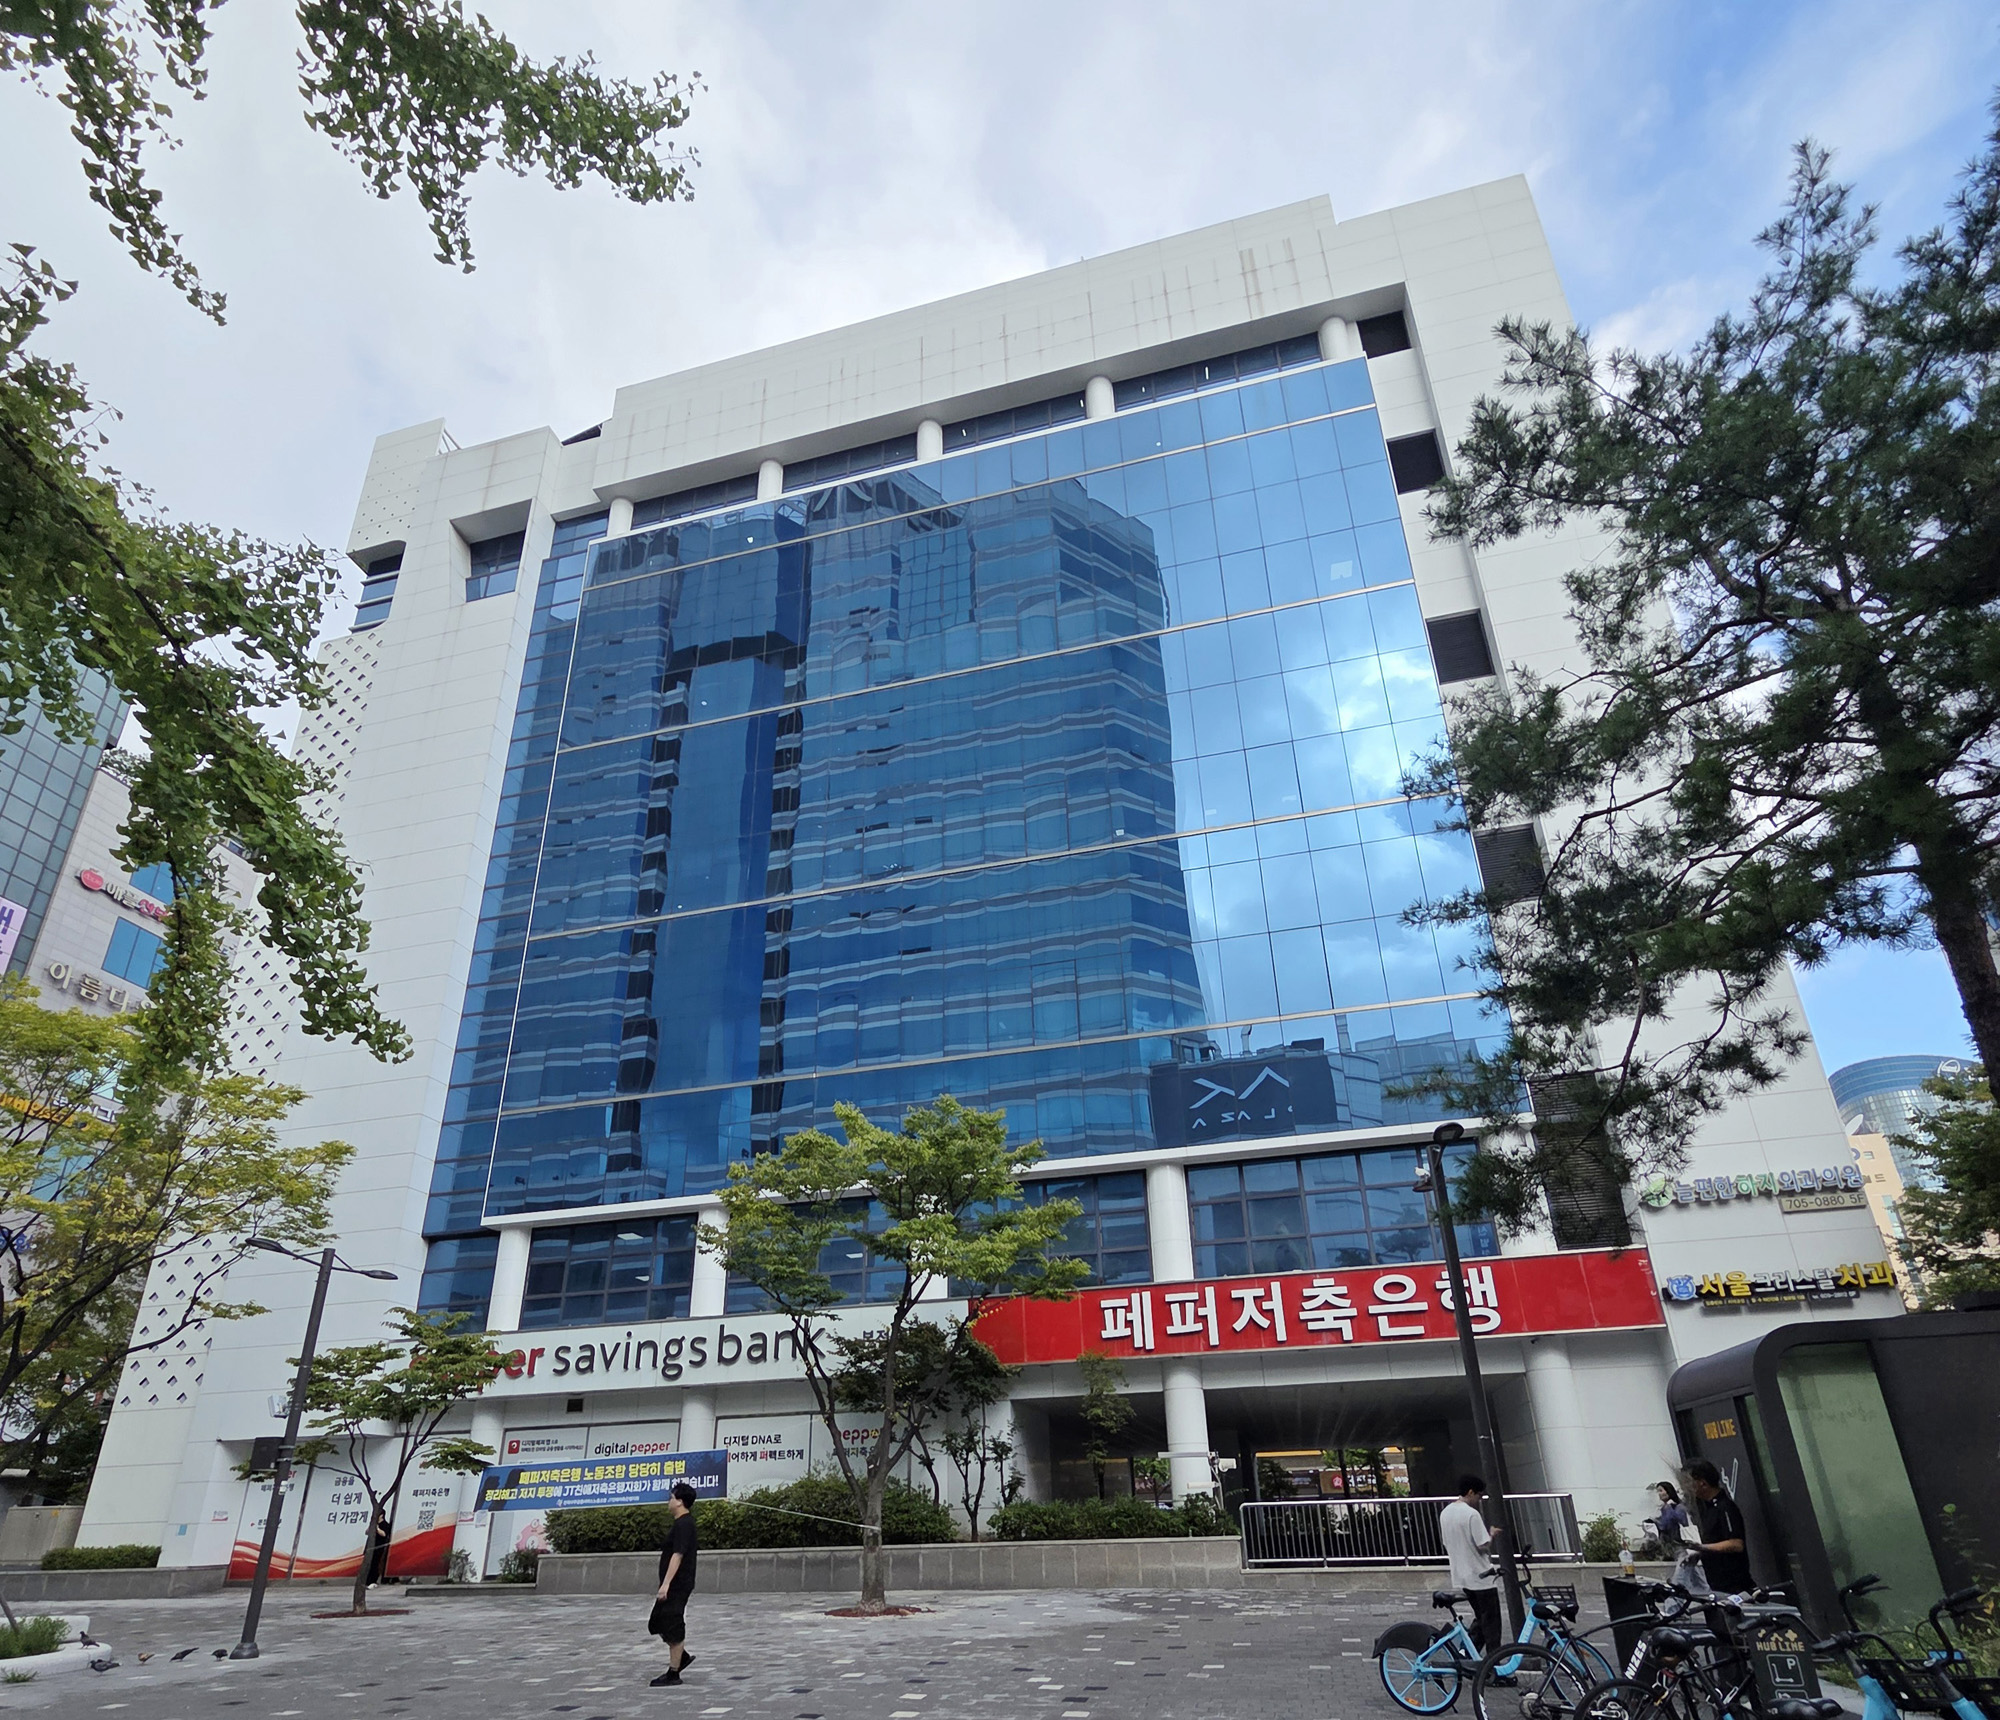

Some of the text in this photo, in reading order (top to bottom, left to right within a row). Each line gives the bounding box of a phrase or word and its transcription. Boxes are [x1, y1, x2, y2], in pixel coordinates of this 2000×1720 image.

[49, 962, 158, 1014] 아름다
[1786, 1194, 1865, 1210] 705-0880 5F
[1100, 1265, 1502, 1350] 페퍼저축은행
[553, 1331, 708, 1381] savings
[723, 1434, 783, 1447] 디지털 DNA로
[727, 1450, 758, 1463] 어하게
[519, 1460, 686, 1485] 페퍼저축은행 노동조합 당당히 출범
[331, 1492, 363, 1505] 더 쉽게
[485, 1486, 517, 1502] 정리해고
[519, 1486, 535, 1499] 저지
[327, 1511, 369, 1524] 더 가깝게
[1756, 1641, 1778, 1652] HUB
